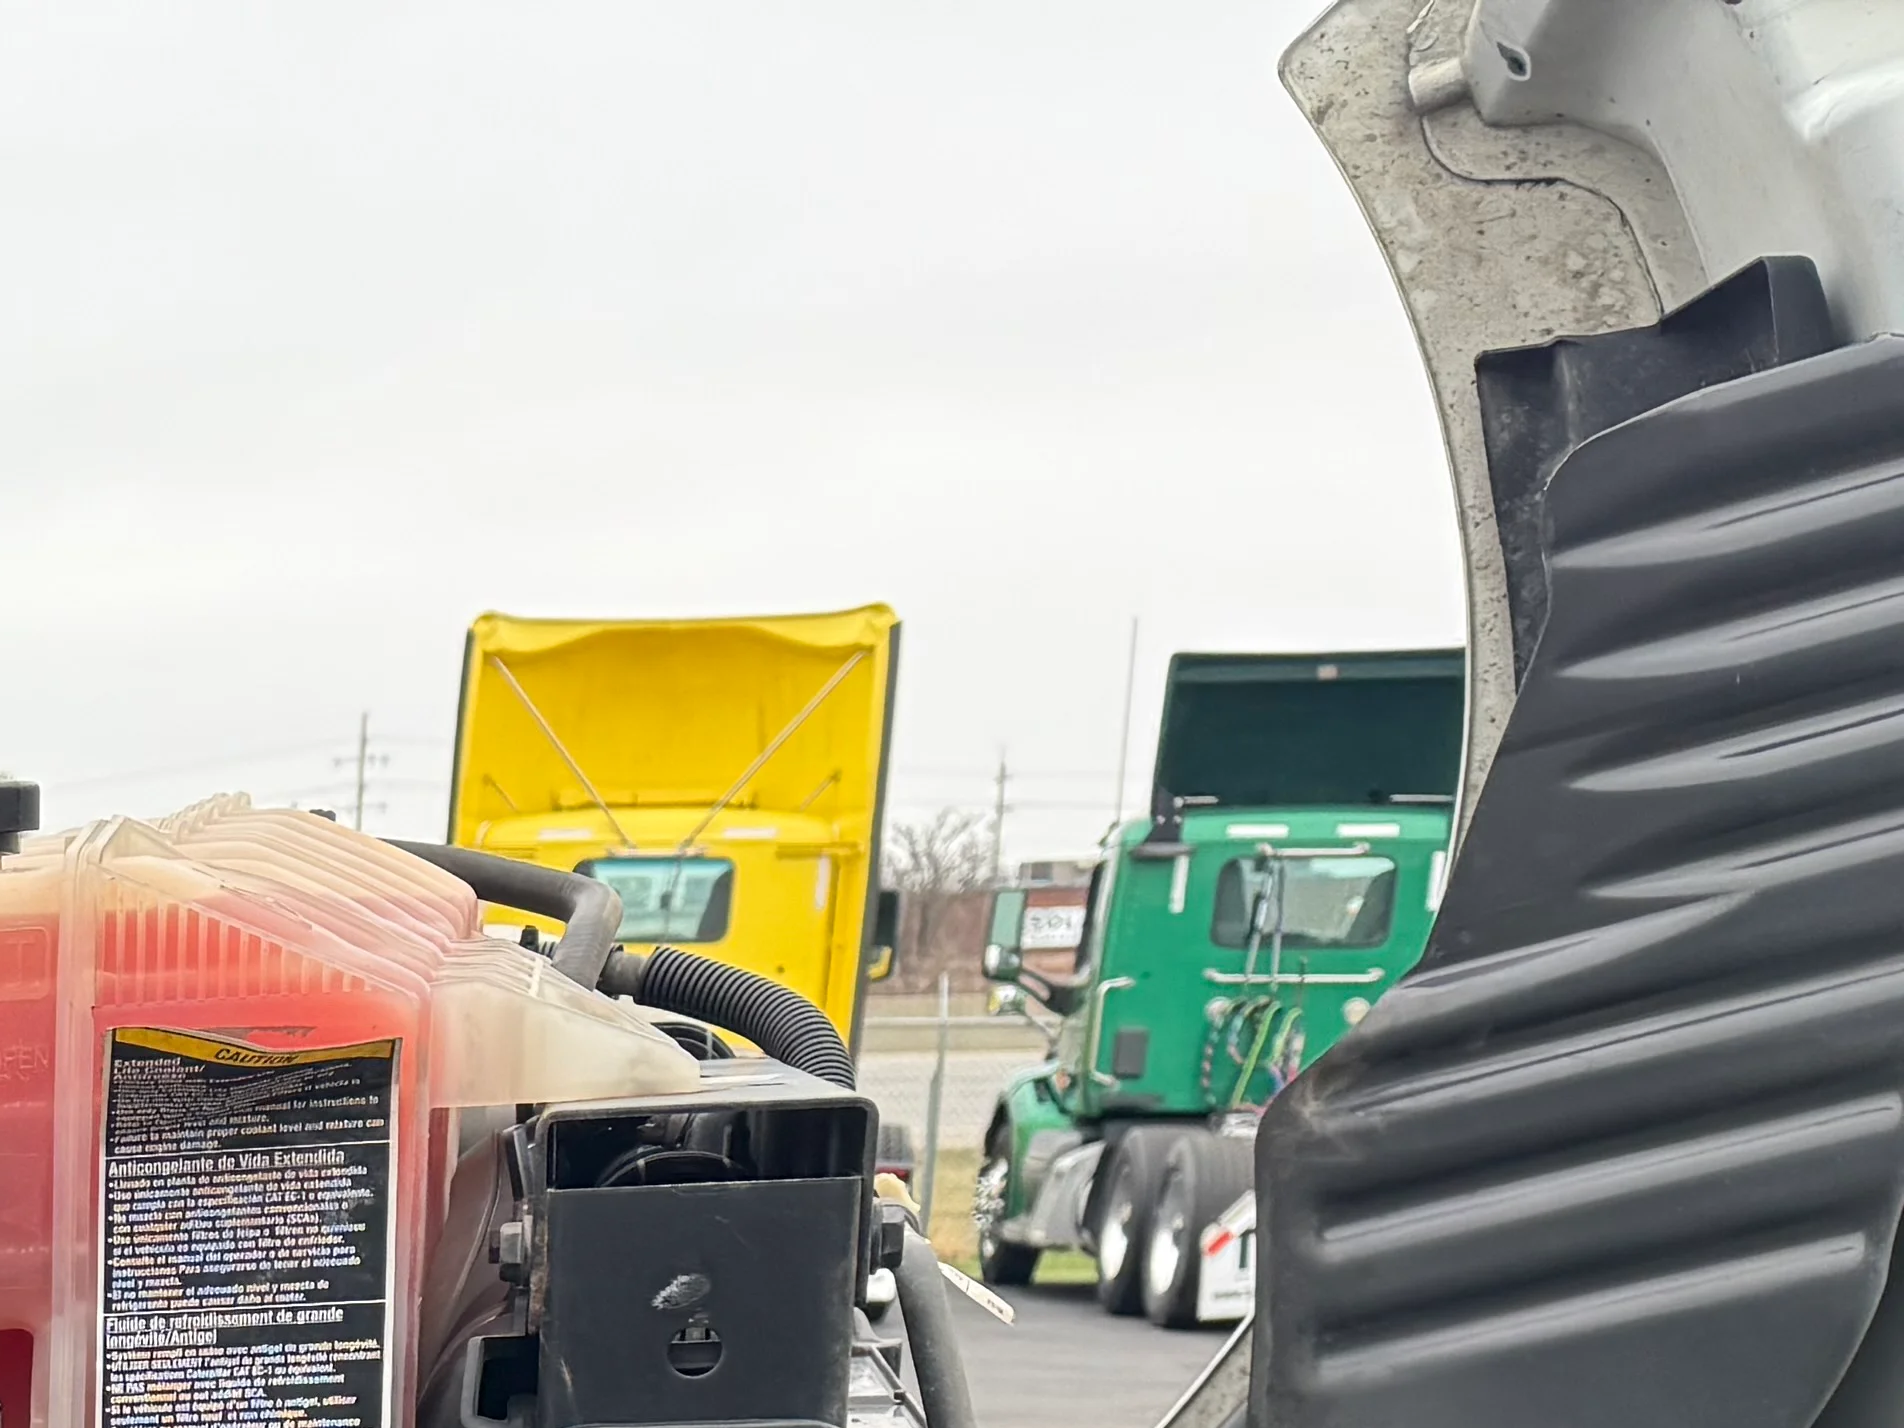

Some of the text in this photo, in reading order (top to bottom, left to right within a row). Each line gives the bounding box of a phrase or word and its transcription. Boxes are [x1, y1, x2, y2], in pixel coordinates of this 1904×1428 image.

[114, 1057, 181, 1067] Extended
[214, 1047, 299, 1066] CAUTION
[109, 1157, 214, 1177] Anticongelante
[239, 1153, 268, 1169] Vida
[275, 1149, 345, 1166] Extendida
